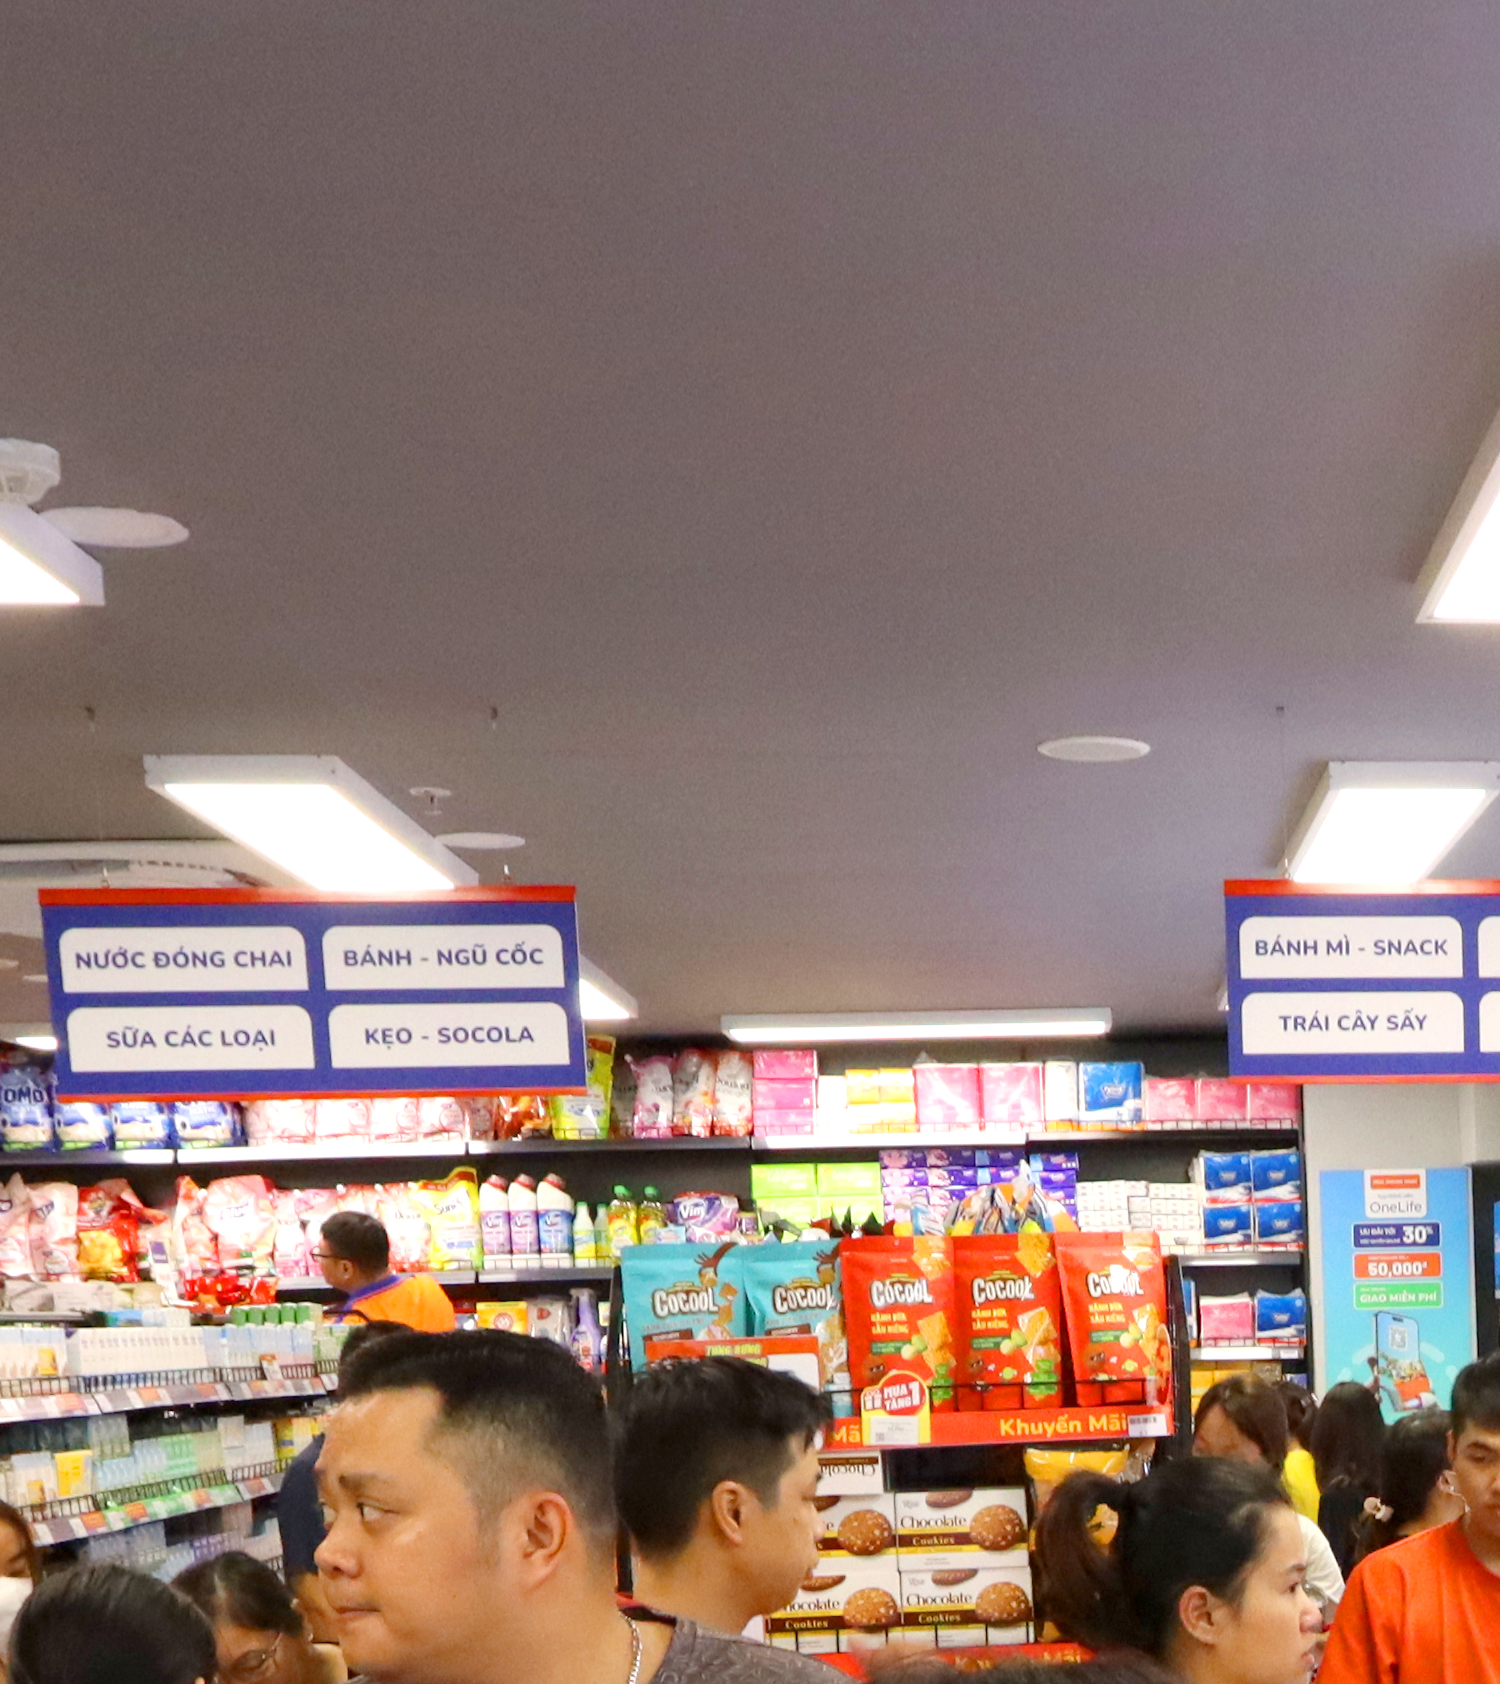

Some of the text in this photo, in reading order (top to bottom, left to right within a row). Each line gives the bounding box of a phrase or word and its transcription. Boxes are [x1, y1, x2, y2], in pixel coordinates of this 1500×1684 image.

[1255, 935, 1448, 957] BÁNH MÌ SNACK
[75, 945, 293, 971] NƯỚC ĐÓNG CHAI
[343, 940, 544, 968] BÁNH NGŨ CỐC
[1279, 1006, 1428, 1033] TRÁI CÂY SẤY
[107, 1025, 276, 1052] SỮA CÁC LOẠI
[365, 1026, 534, 1051] KẸO SOCOLA
[1370, 1201, 1422, 1213] OneLife
[883, 1386, 908, 1399] MUA
[1000, 1413, 1127, 1438] Khuyến Mãi
[900, 1515, 967, 1529] Chocolate
[912, 1535, 955, 1546] Cookies
[783, 1598, 840, 1612] hocolate
[906, 1592, 972, 1607] Chocolate
[785, 1619, 829, 1629] Cookies
[918, 1613, 961, 1624] Cookies
